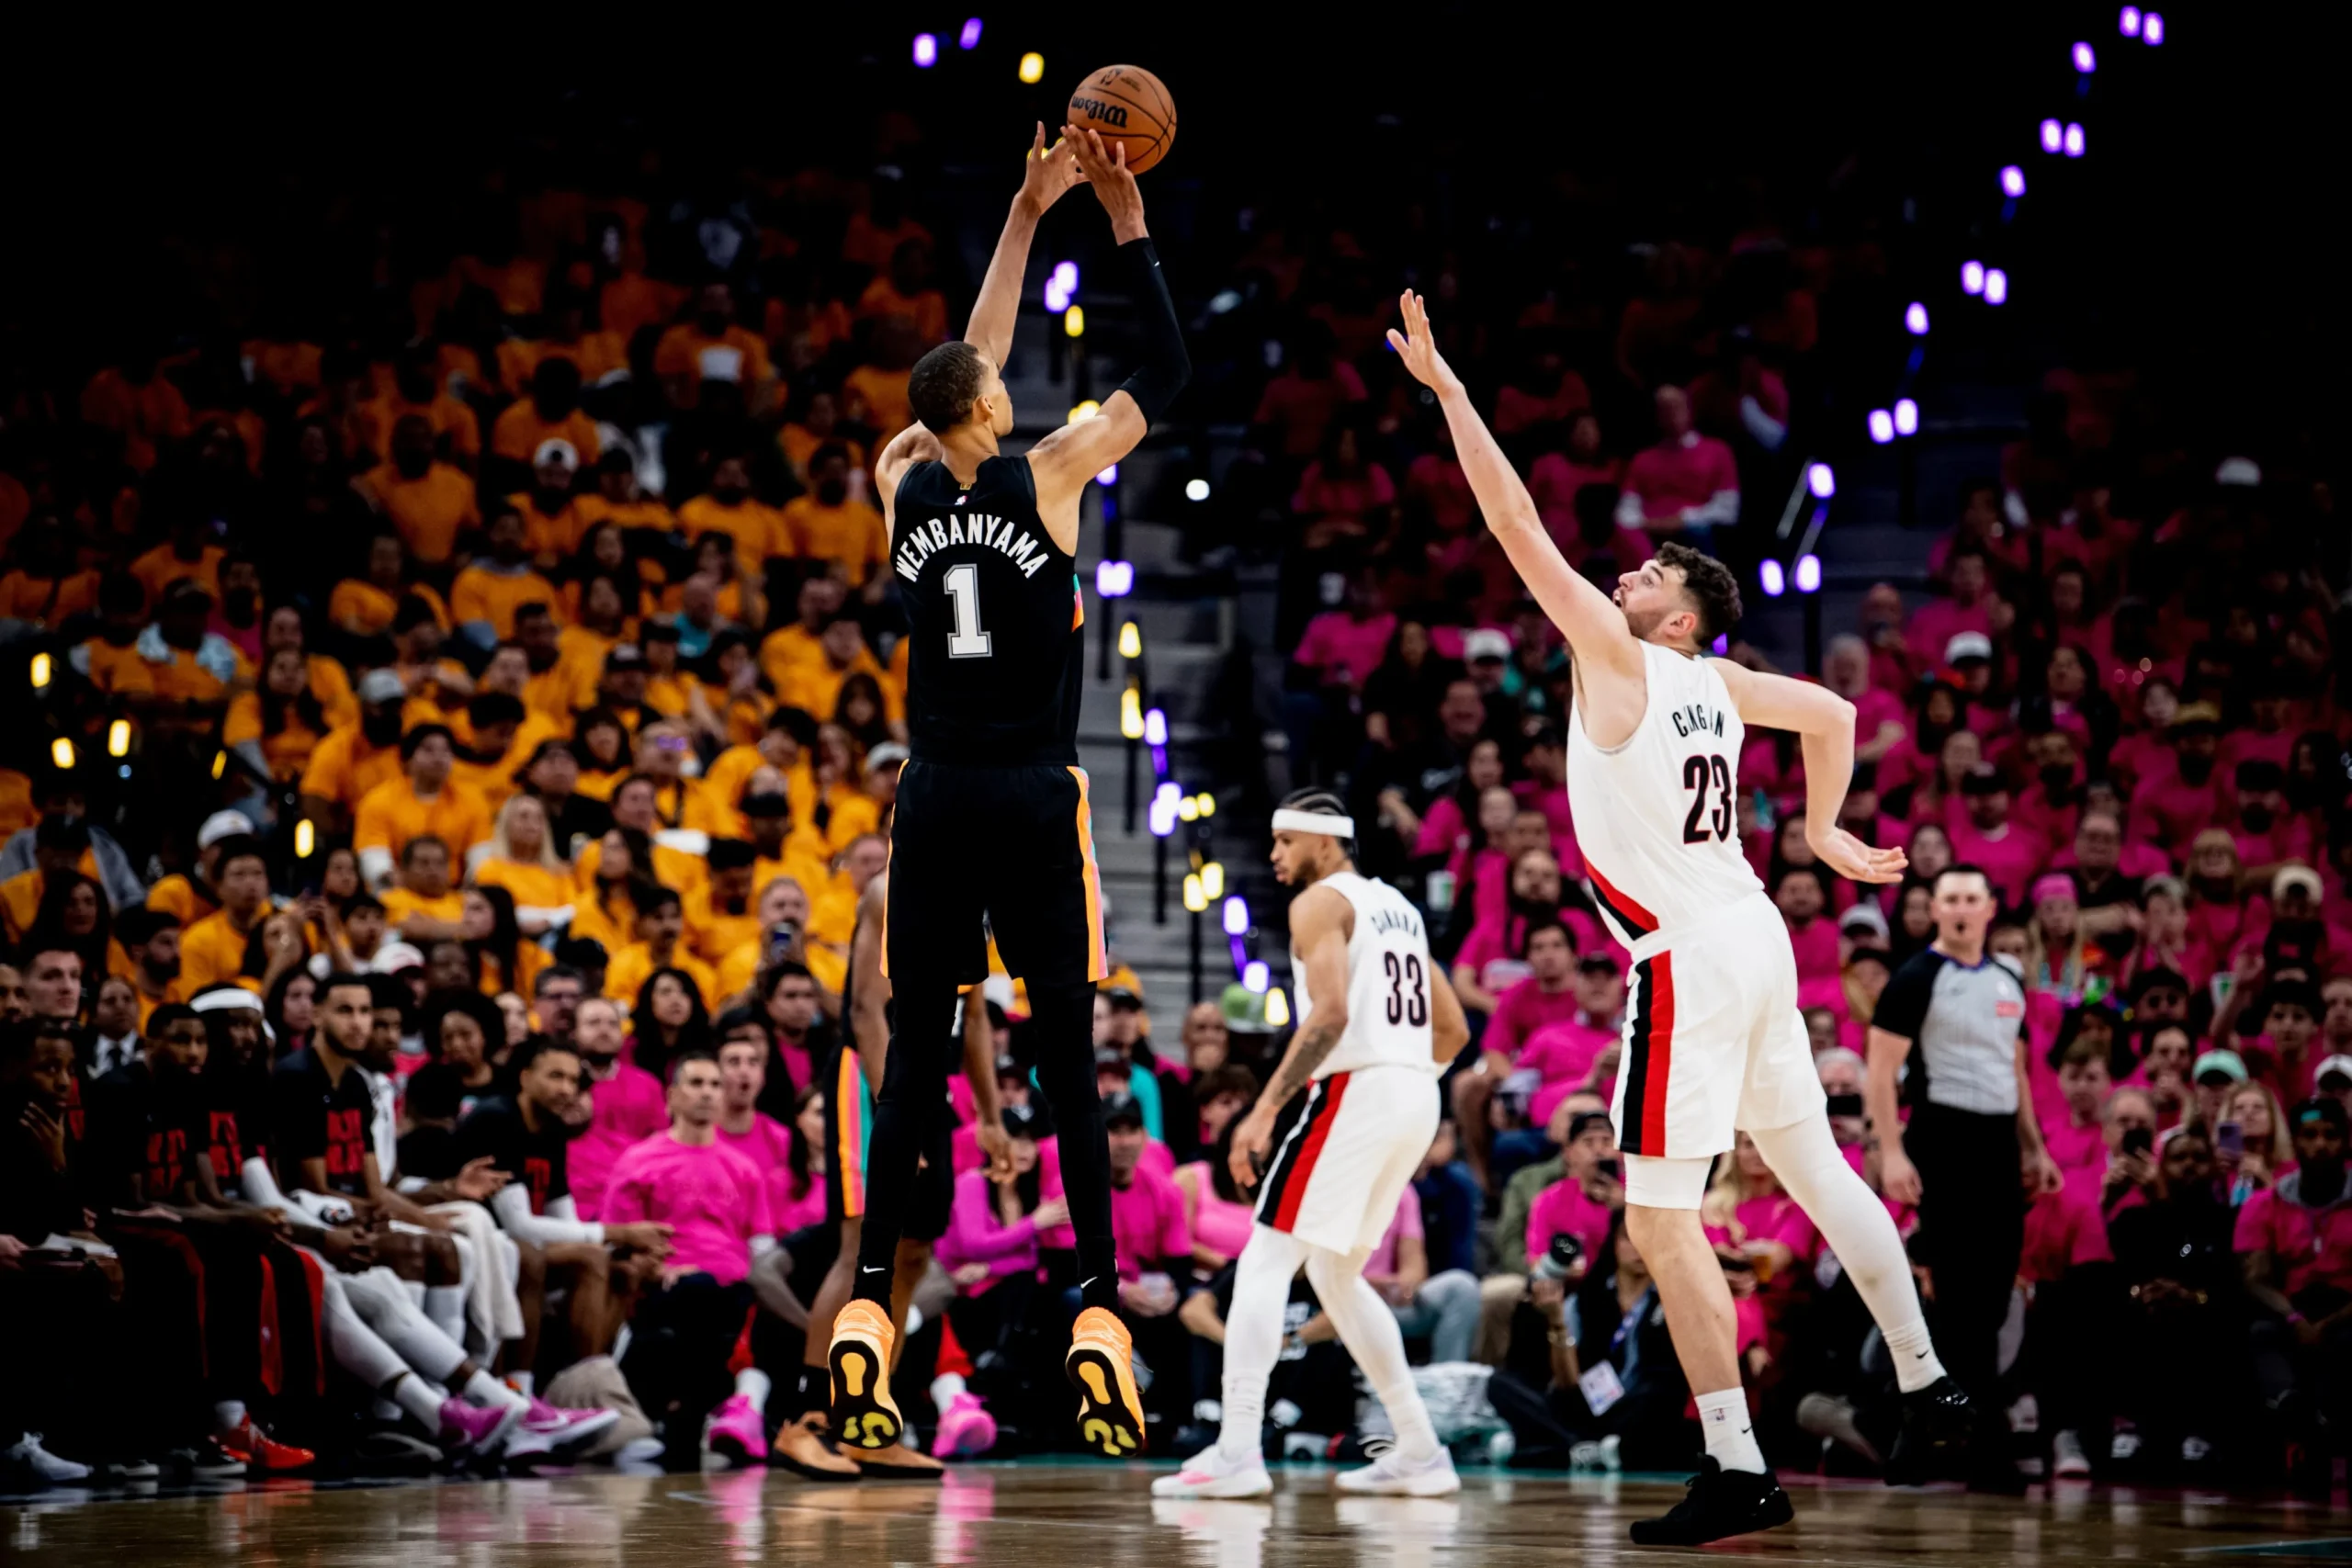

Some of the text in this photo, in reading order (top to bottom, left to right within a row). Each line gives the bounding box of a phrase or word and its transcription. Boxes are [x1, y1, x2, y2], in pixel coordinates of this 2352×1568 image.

[1070, 95, 1128, 129] Wilson
[896, 513, 1049, 583] WEMBANYAMA
[943, 563, 993, 660] 1
[1683, 753, 1732, 844] 23
[1384, 951, 1427, 1027] 33
